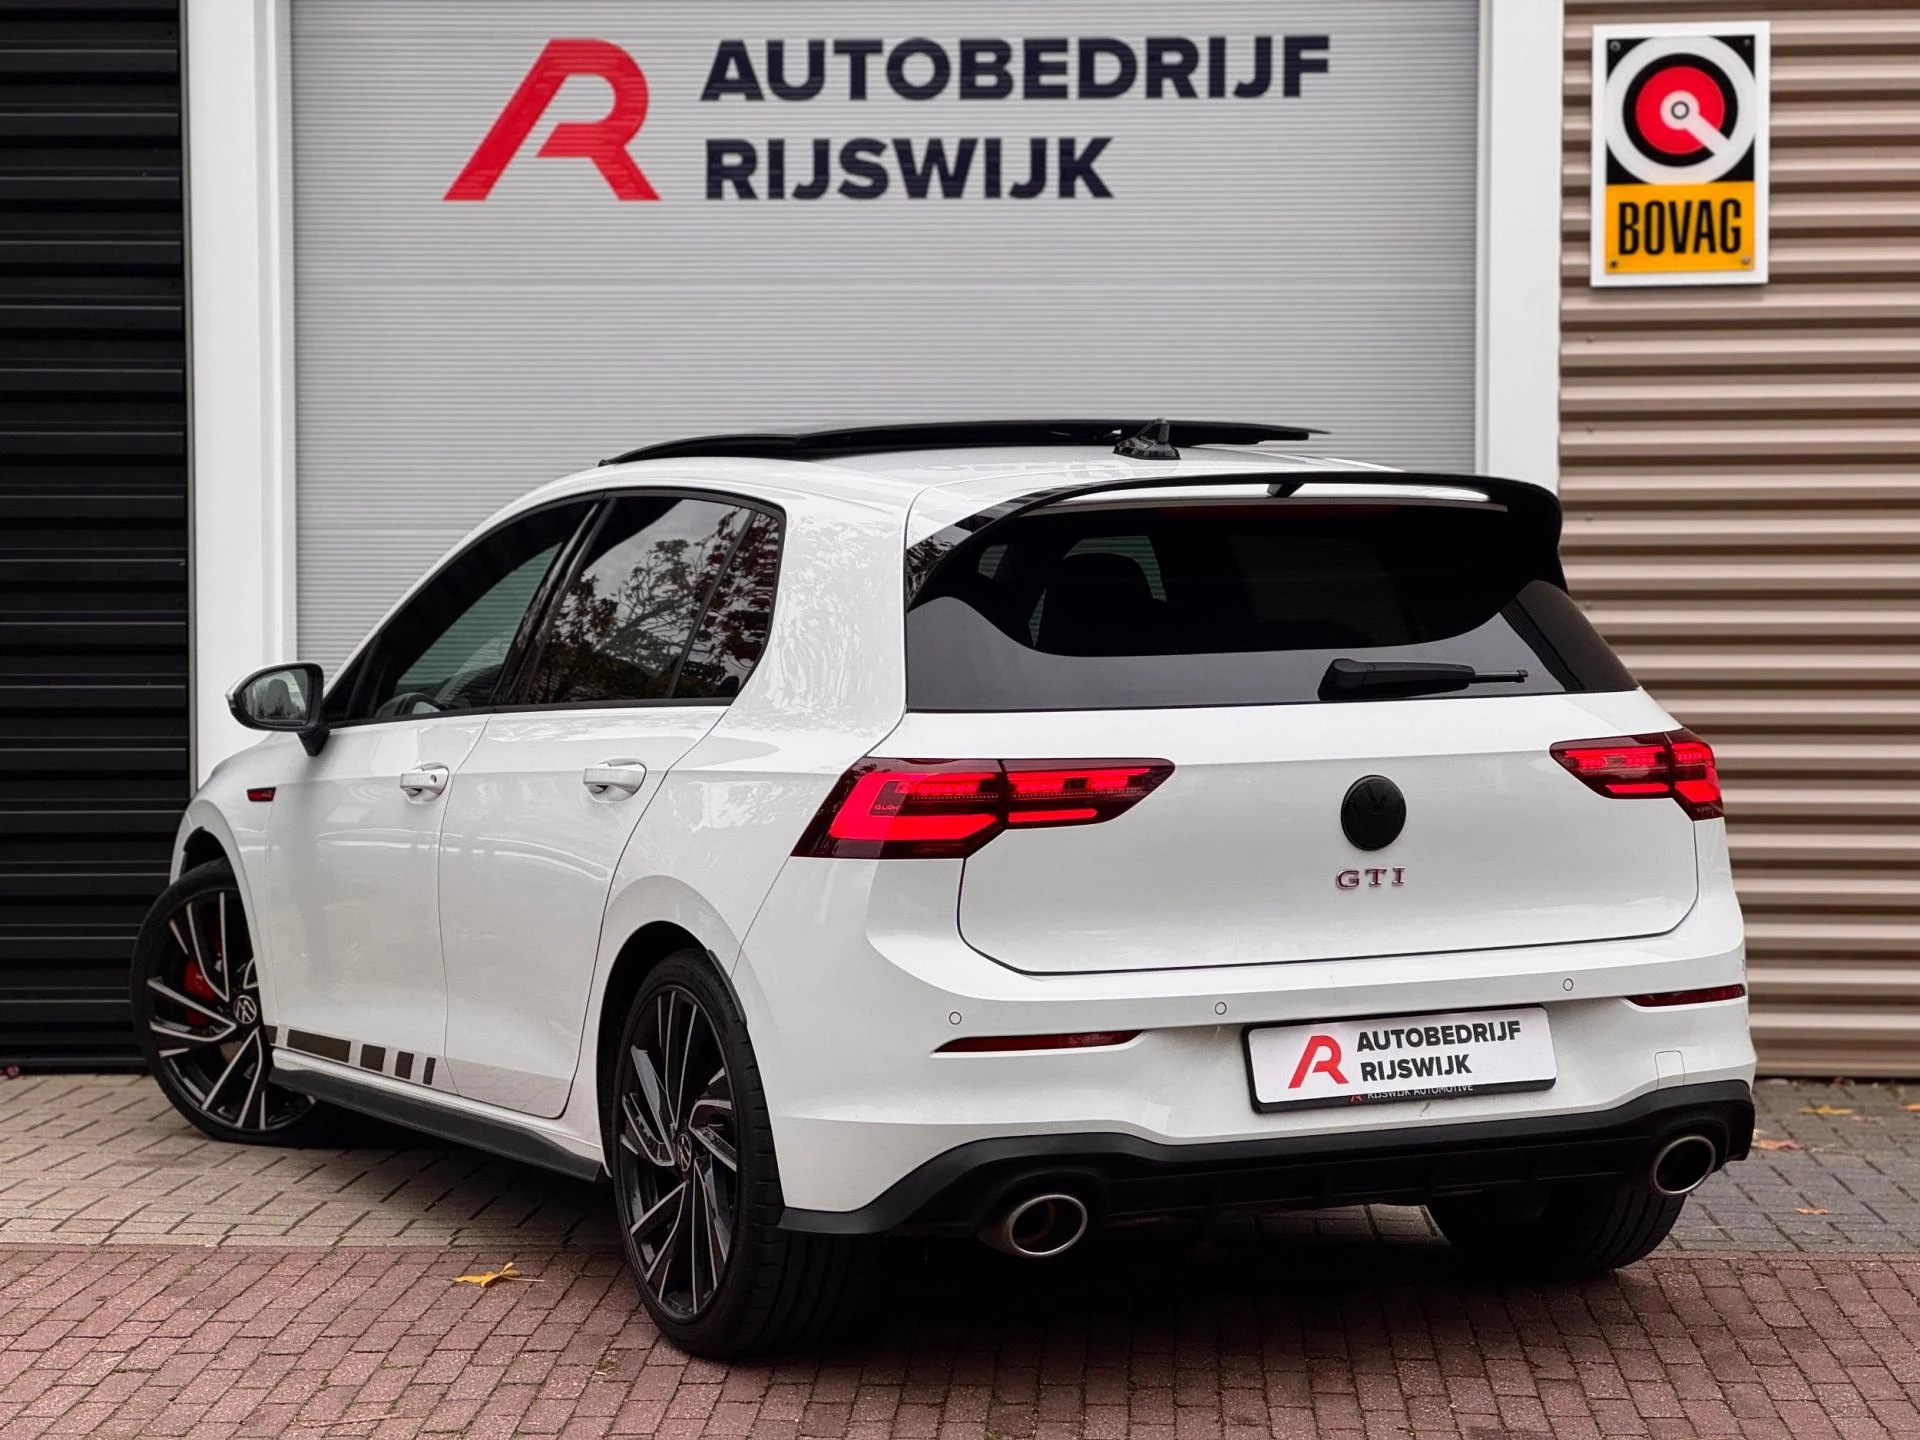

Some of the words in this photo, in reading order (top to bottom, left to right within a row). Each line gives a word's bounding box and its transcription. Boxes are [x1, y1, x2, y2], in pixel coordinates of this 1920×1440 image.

[701, 35, 1331, 102] AUTOBEDRIJF
[705, 137, 1115, 201] RIJSWIJK
[1618, 198, 1742, 256] BOVAG
[1335, 866, 1406, 889] GTI
[1357, 1020, 1522, 1052] AUTOBEDRIJF
[1360, 1054, 1472, 1082] RIJSWIJK
